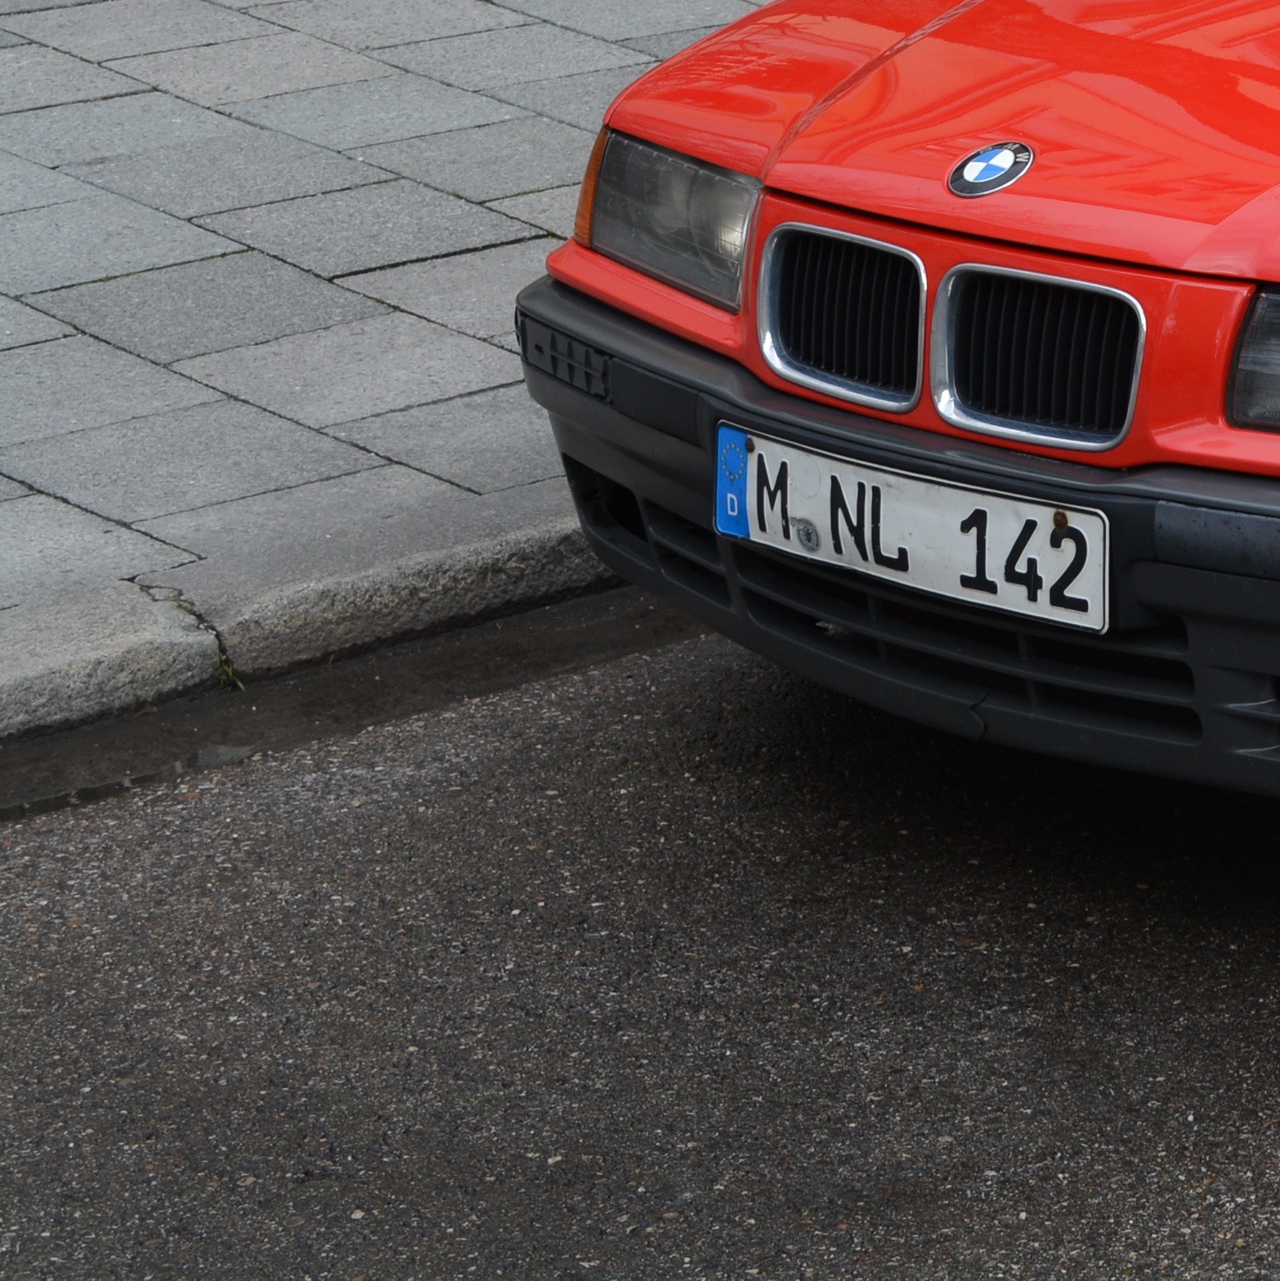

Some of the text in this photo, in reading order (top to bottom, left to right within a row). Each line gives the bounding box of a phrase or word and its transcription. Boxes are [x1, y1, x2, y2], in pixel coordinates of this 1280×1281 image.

[727, 493, 738, 516] D
[756, 452, 1089, 613] M NL 142
